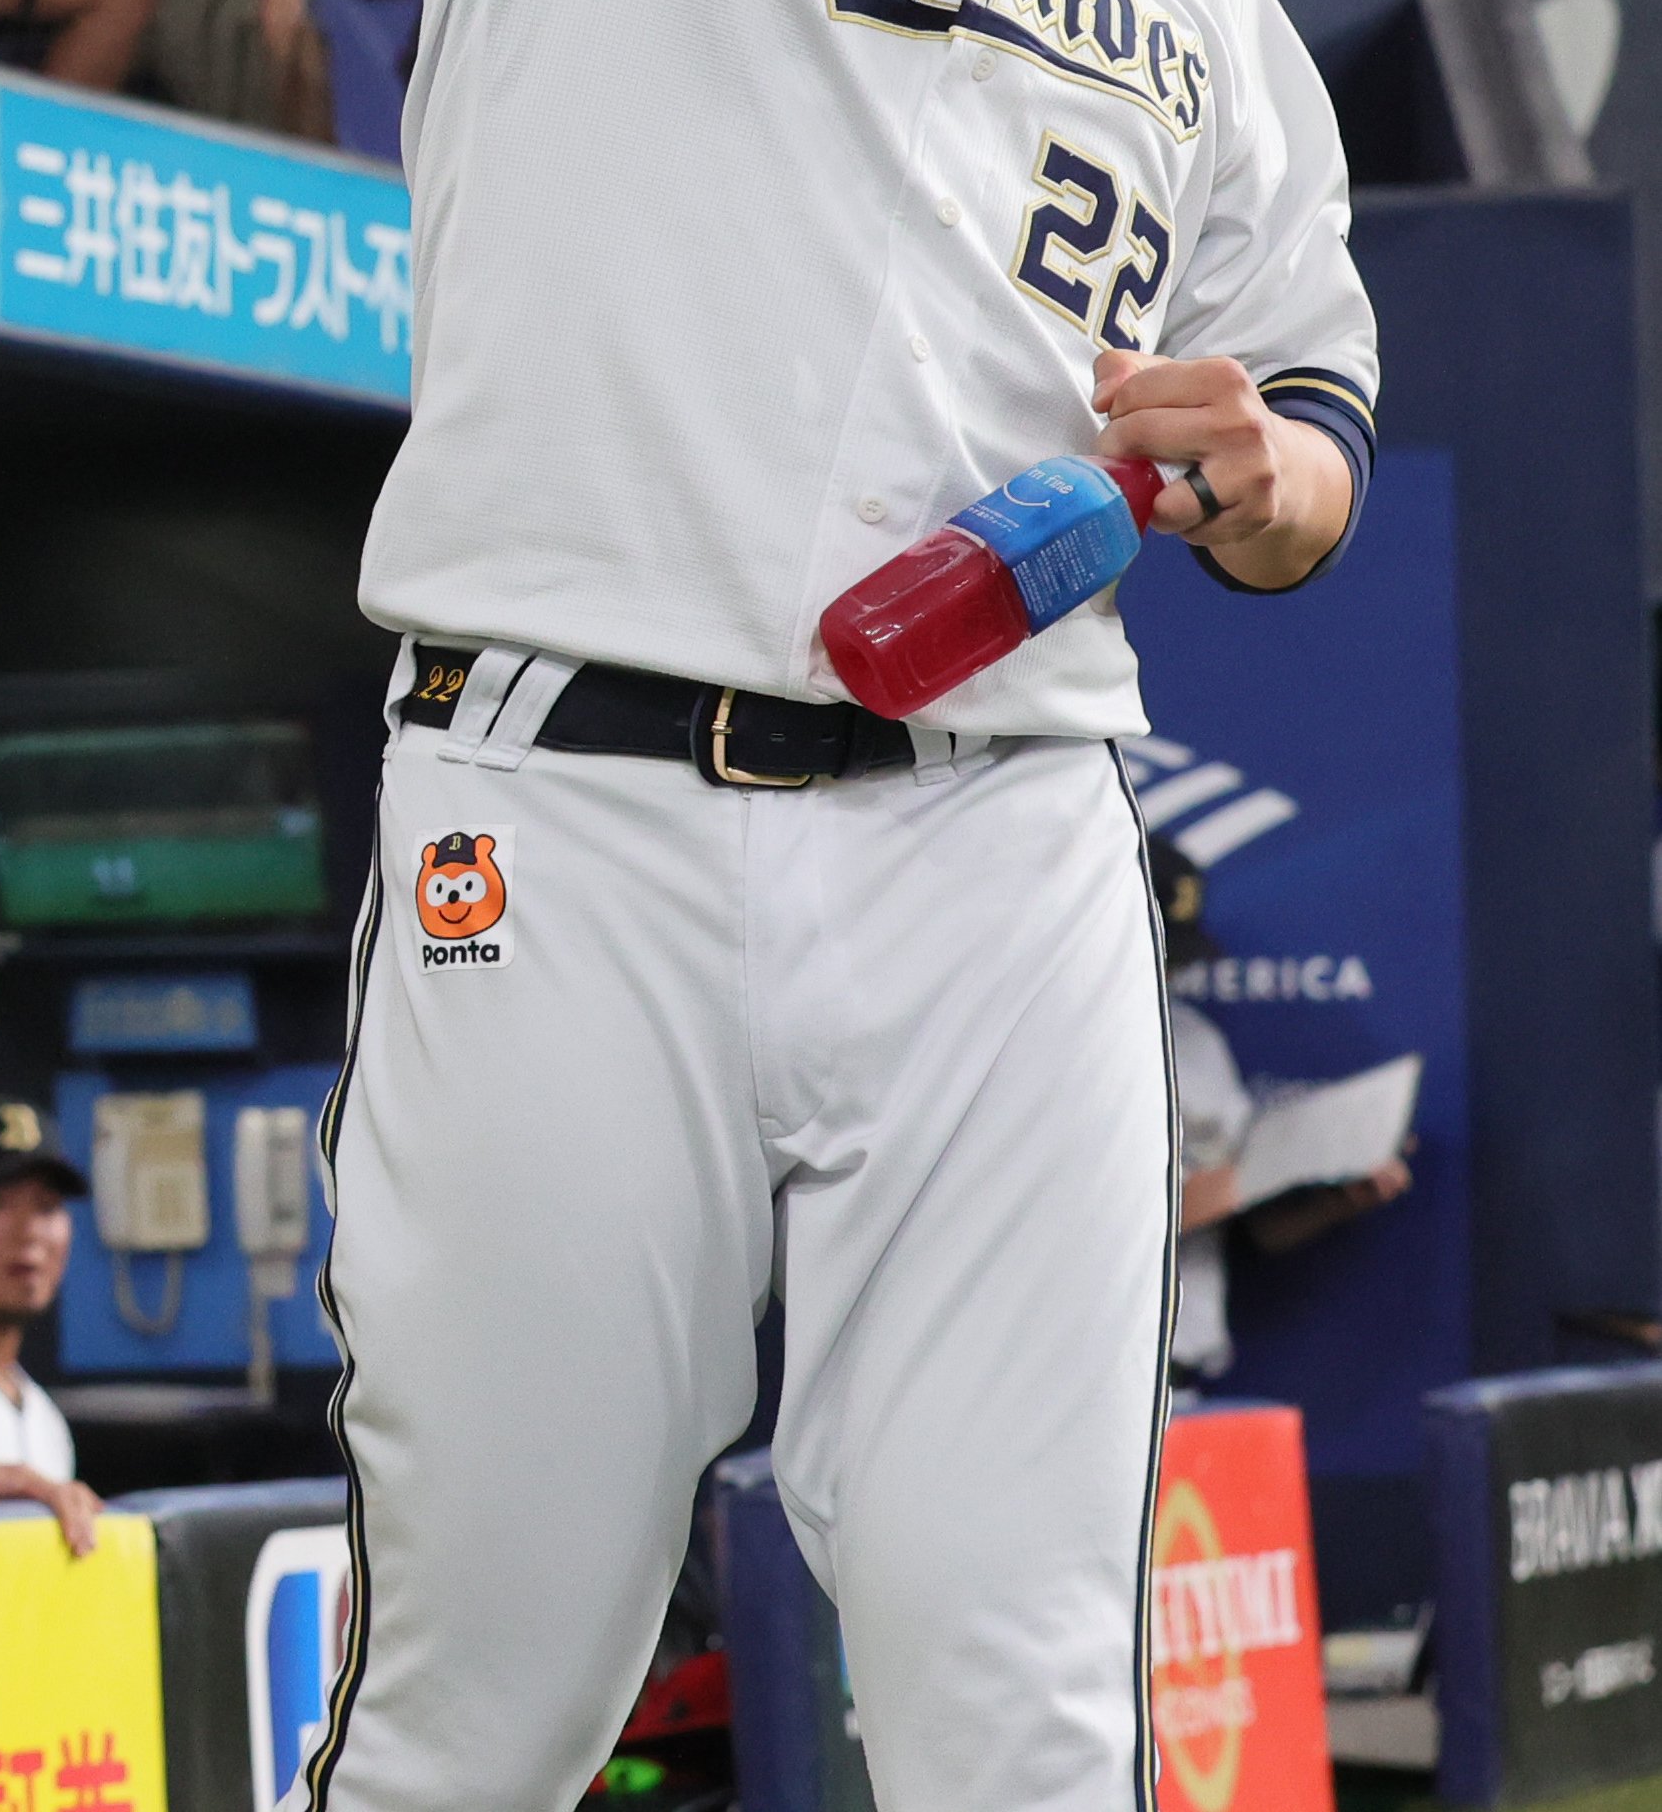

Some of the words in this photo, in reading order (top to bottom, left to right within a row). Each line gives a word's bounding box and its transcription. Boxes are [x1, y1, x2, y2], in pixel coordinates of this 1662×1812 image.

[14, 140, 414, 356] 三井住友トラスト不
[1009, 128, 1174, 354] 22
[418, 665, 465, 702] 22
[1167, 955, 1374, 1003] MERICA
